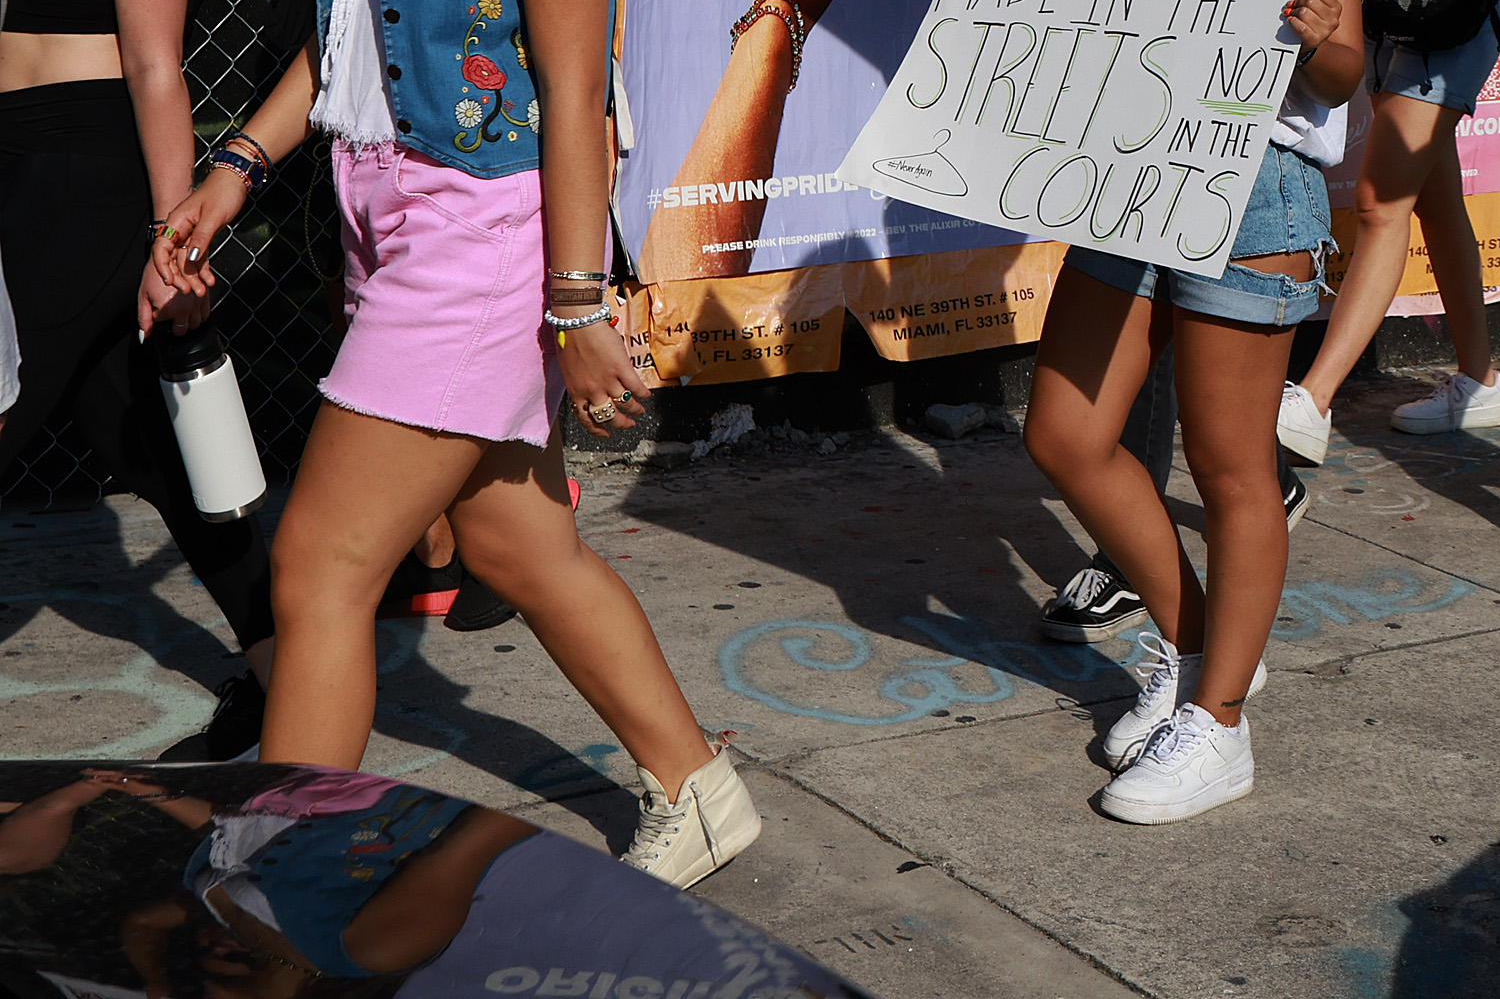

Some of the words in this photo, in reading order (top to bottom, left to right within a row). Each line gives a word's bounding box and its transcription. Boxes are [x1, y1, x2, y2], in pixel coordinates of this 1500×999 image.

[906, 17, 1178, 154] STREETS
[1204, 47, 1295, 101] NOT
[1168, 118, 1202, 154] IN
[1210, 120, 1258, 159] THE
[647, 172, 858, 210] #SERVINGPRID
[998, 146, 1240, 261] COURTS
[702, 241, 744, 255] PLEASE
[745, 237, 777, 251] DRINK
[778, 231, 846, 247] RESPONSIBLY
[908, 222, 929, 232] THE
[930, 218, 961, 230] ALIXIR
[869, 308, 896, 323] 140
[900, 302, 925, 319] NE
[930, 297, 970, 316] 39TH
[974, 293, 997, 312] ST.
[999, 291, 1009, 305] #
[1011, 288, 1035, 303] 105
[741, 323, 769, 340] ST.
[774, 324, 785, 337] #
[790, 319, 821, 334] 105
[893, 320, 951, 342] MIAMI,
[954, 318, 974, 334] FL
[975, 311, 1018, 331] 33137
[713, 350, 737, 364] FL
[741, 344, 795, 362] 33137
